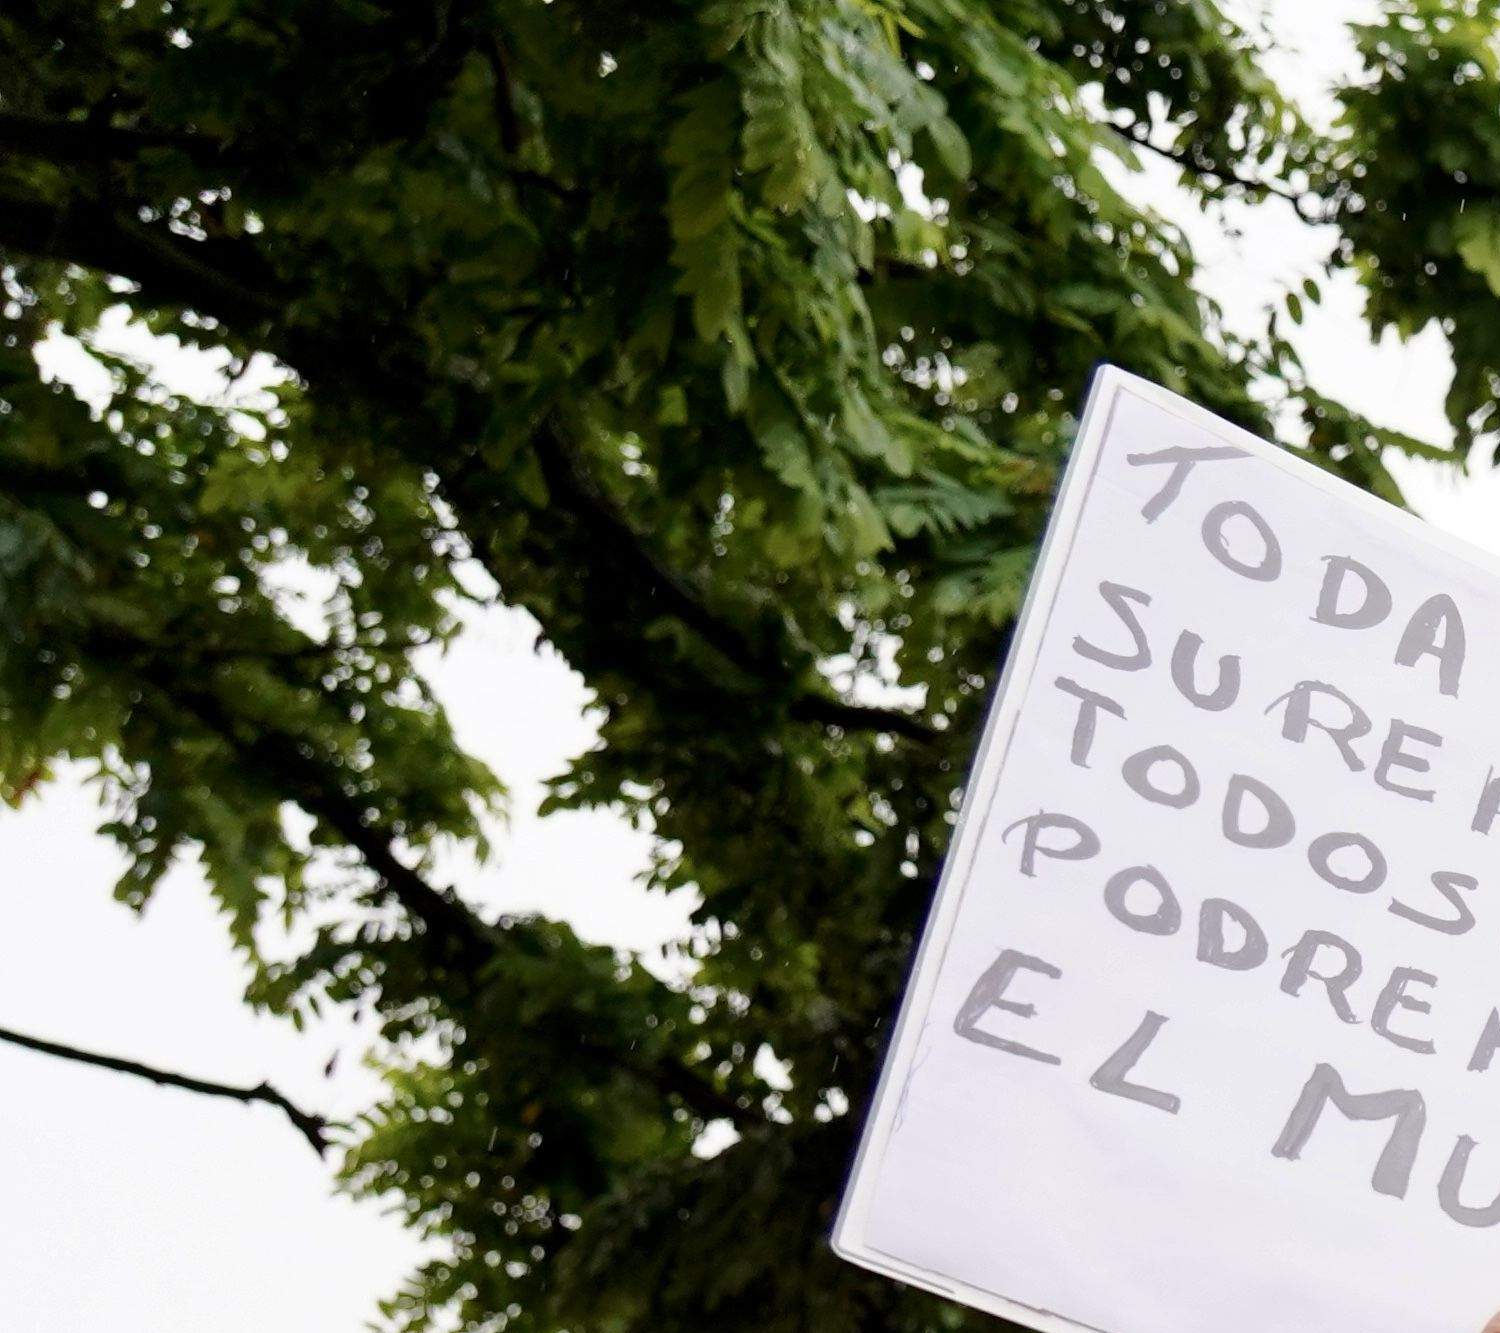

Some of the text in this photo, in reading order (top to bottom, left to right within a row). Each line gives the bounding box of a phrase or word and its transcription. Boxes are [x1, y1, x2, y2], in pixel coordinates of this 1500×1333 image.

[1070, 578, 1242, 712] SU
[1125, 445, 1464, 698] TODA
[950, 945, 1185, 1115] EL
